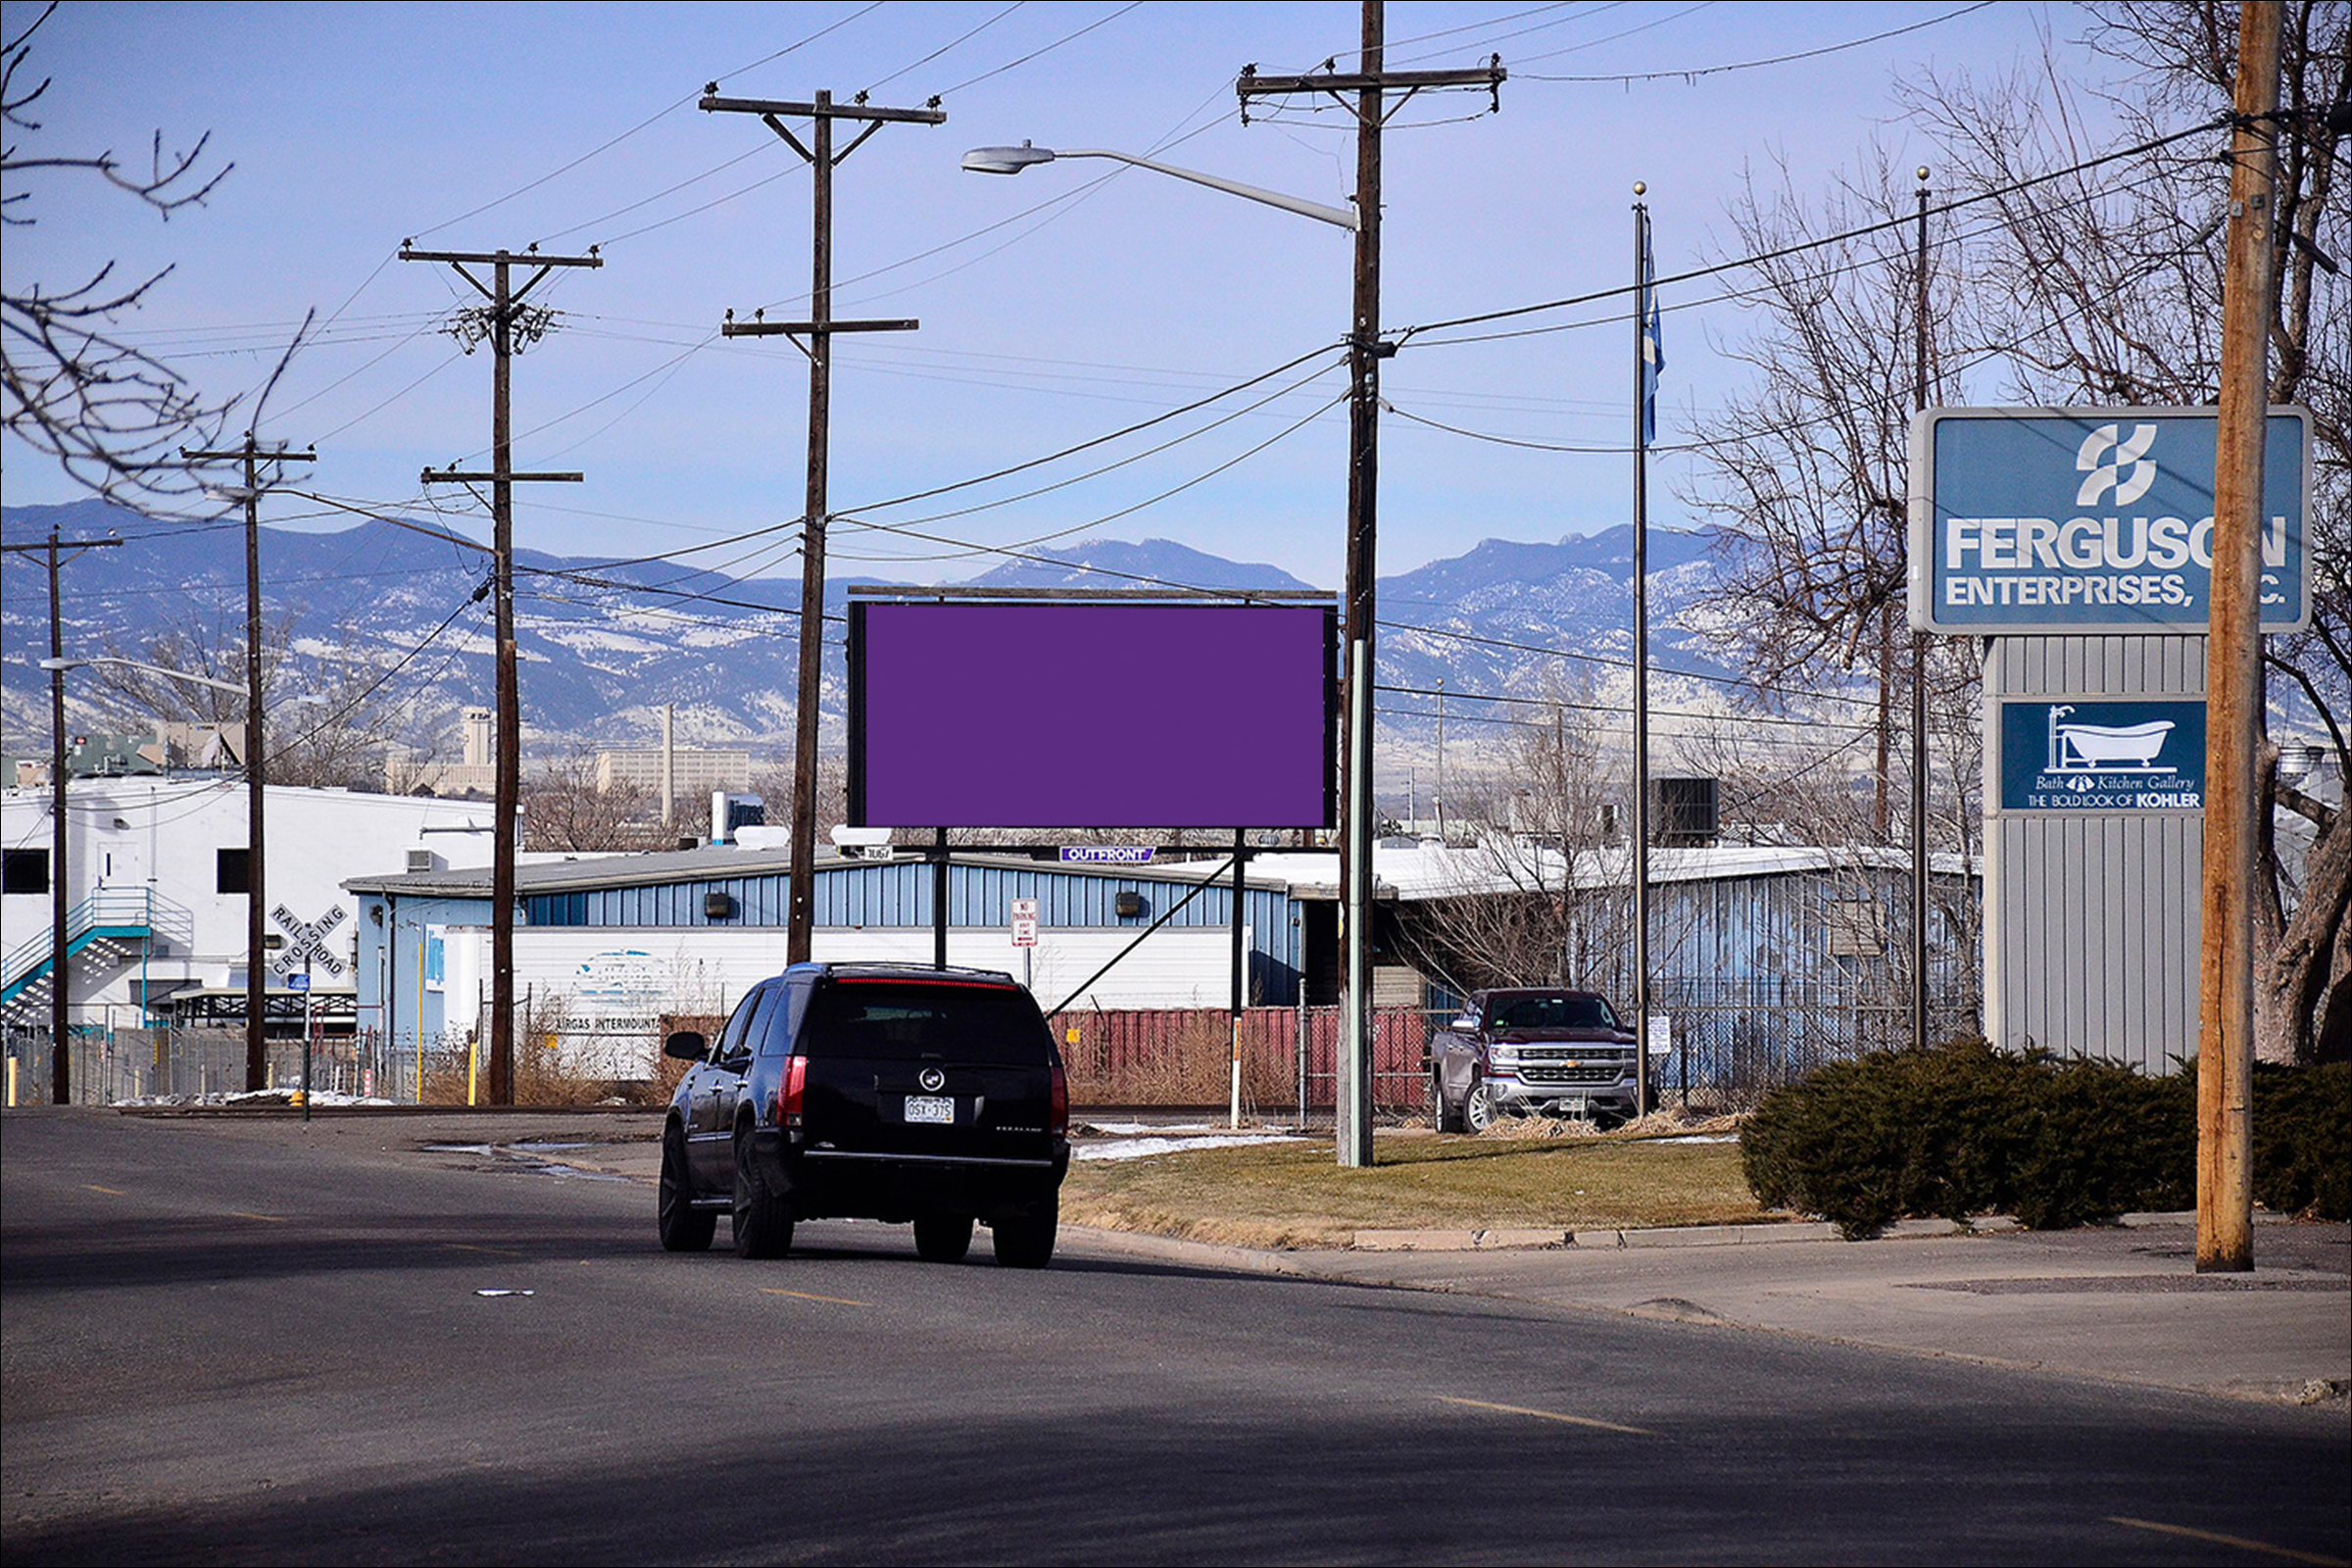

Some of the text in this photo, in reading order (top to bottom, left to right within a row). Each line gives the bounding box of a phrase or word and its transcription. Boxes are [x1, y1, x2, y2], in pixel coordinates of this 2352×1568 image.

[1946, 575, 2194, 608] ENTERPRISES,
[2035, 775, 2195, 792] Bath Kitchen Gallery
[2028, 793, 2201, 808] THE BOLD LOOK OF KOHLER
[1068, 849, 1146, 861] OUTFRONT
[273, 907, 342, 974] RAIL ROAD
[273, 908, 343, 975] CROSSING
